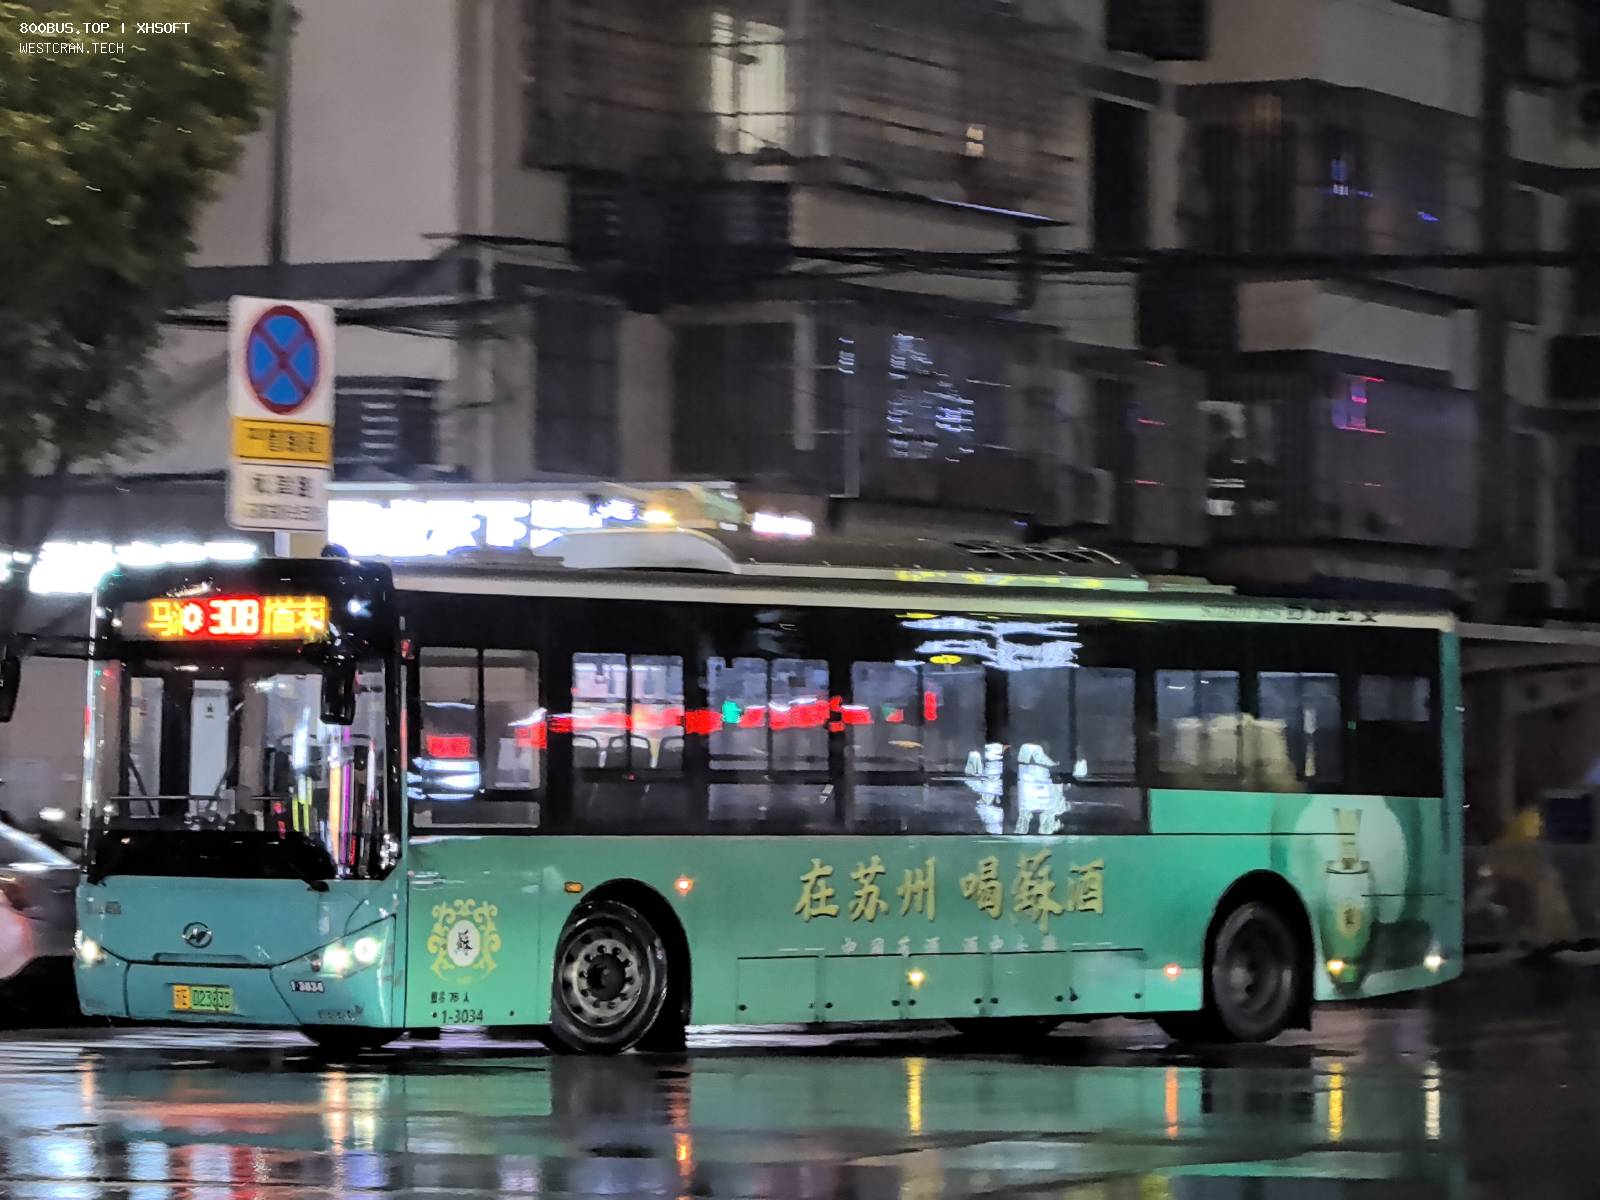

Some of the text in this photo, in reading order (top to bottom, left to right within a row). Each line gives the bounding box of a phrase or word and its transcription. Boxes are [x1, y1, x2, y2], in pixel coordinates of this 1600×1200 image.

[208, 598, 260, 635] 308
[794, 854, 937, 923] 在苏州
[441, 1008, 484, 1024] 1-3034
